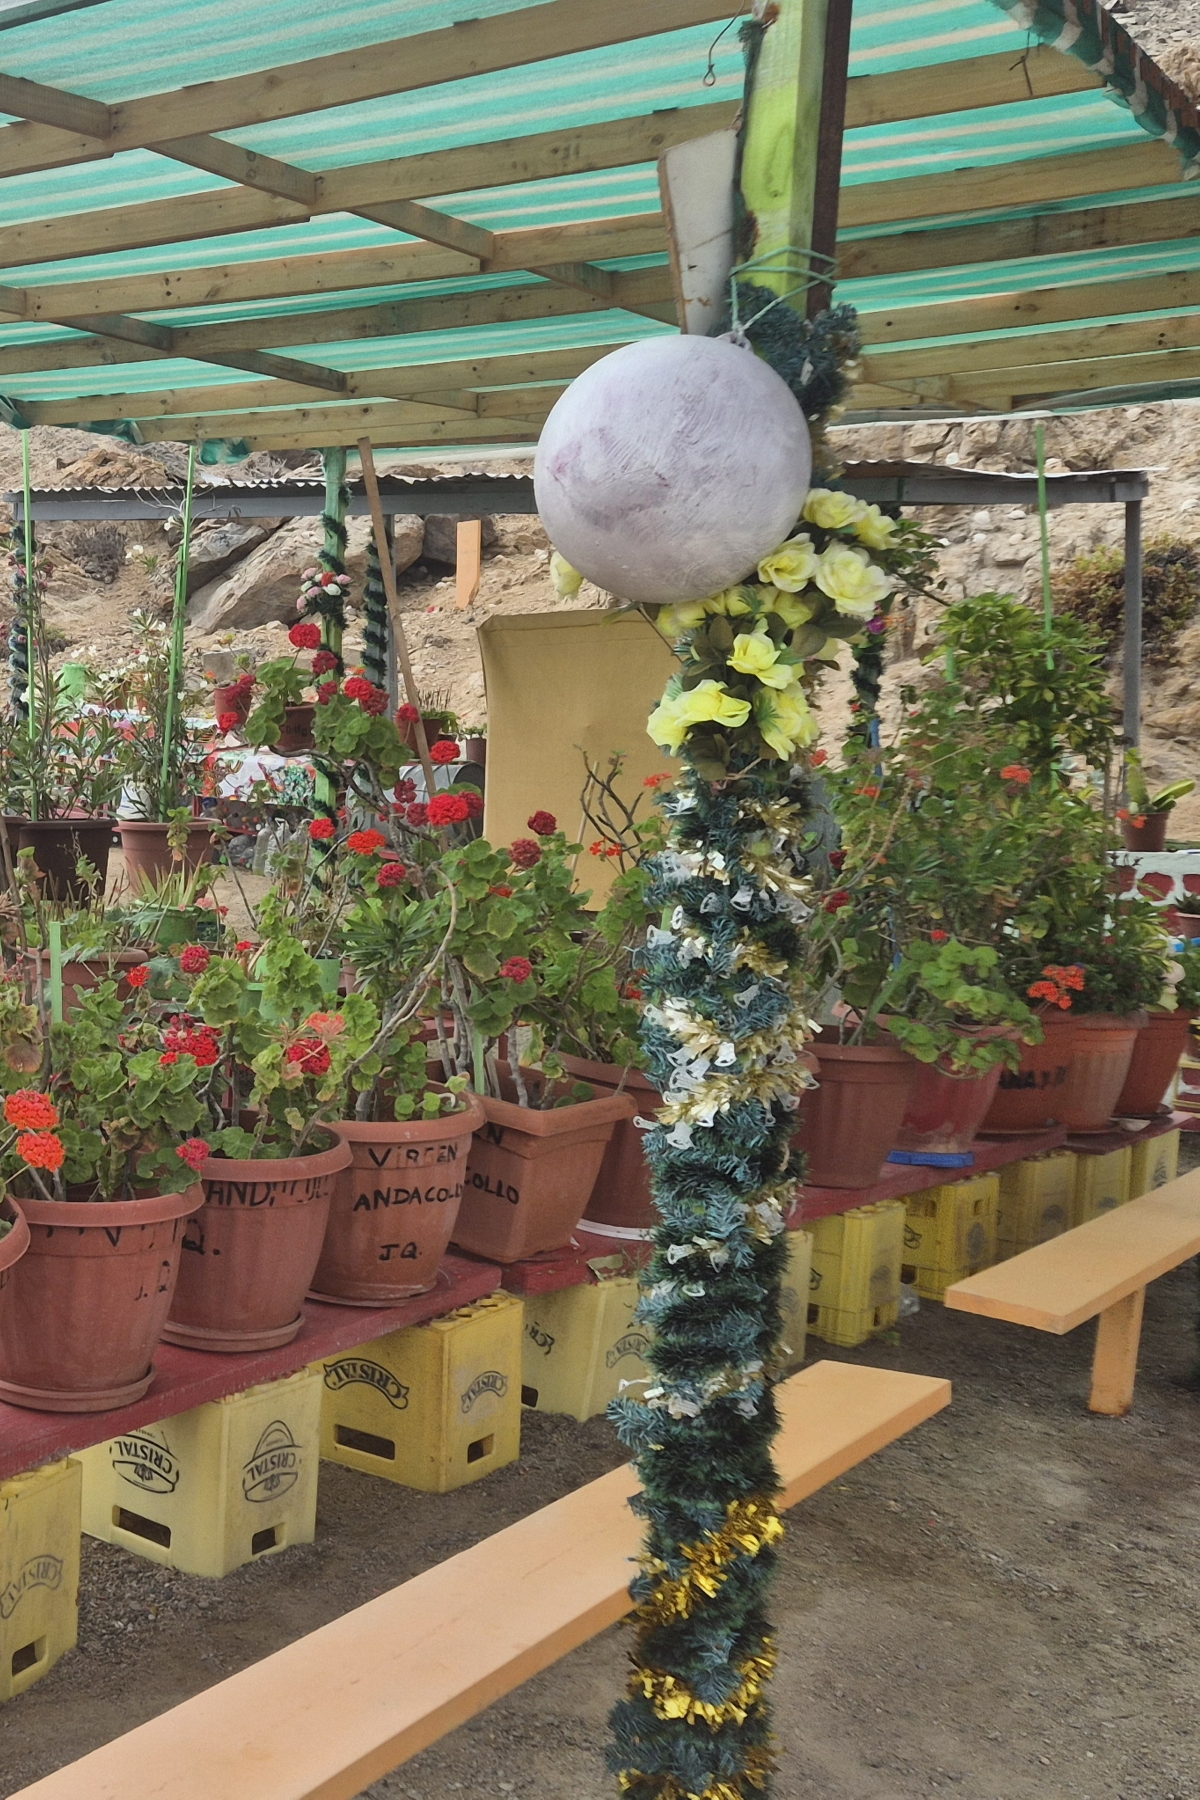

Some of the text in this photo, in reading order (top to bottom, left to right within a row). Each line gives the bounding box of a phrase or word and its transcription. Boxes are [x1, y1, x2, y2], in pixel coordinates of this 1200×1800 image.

[329, 1361, 402, 1399] CRISTAL
[462, 1373, 506, 1403] CRISTAL
[113, 1440, 173, 1475] CRISTAL
[246, 1452, 296, 1482] CRISTAL
